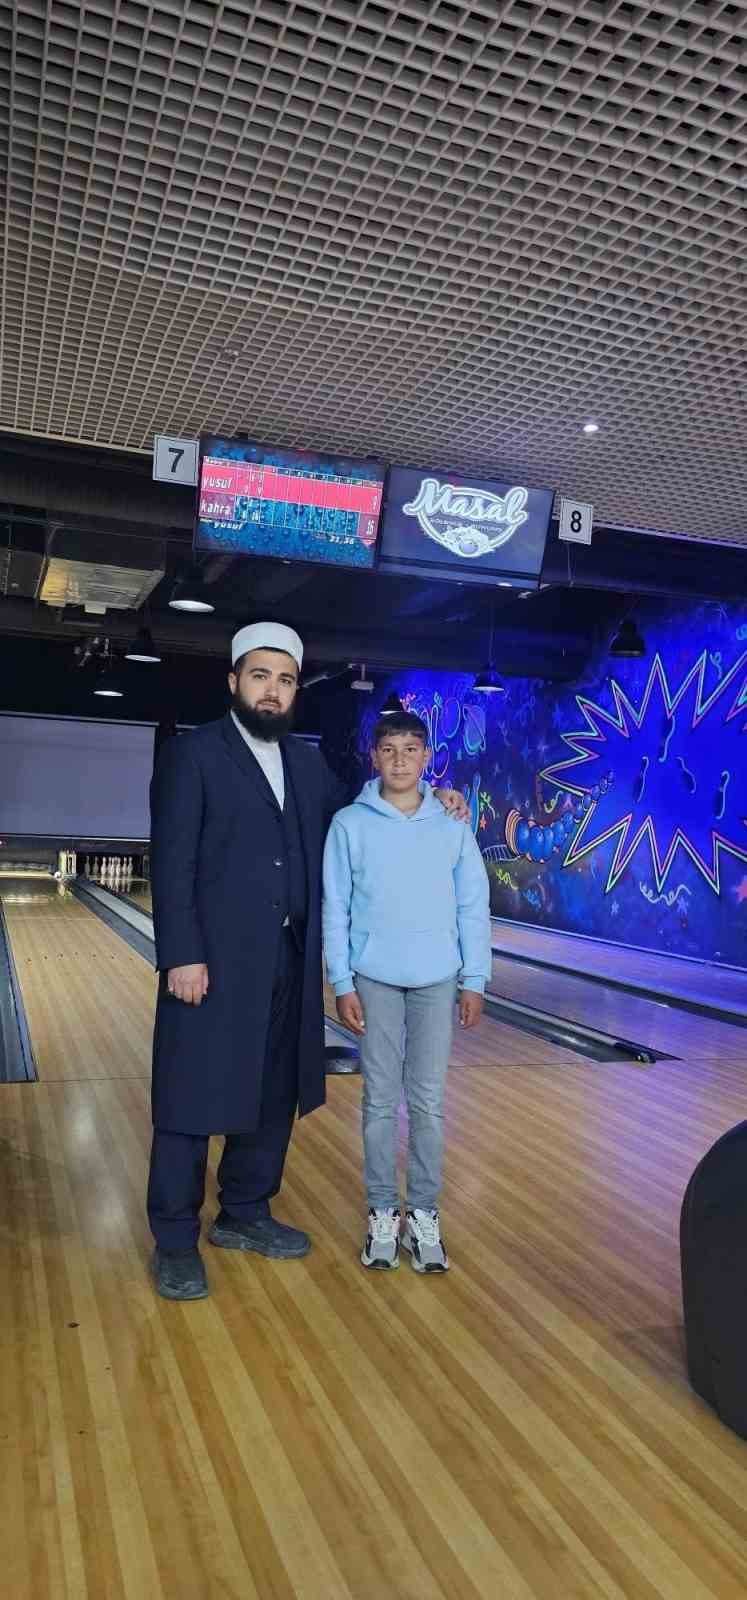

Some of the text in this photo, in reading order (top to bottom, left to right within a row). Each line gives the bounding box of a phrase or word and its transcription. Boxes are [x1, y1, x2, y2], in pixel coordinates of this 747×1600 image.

[168, 447, 185, 473] 7
[202, 475, 233, 489] yusuf
[403, 478, 528, 525] Masal
[213, 520, 244, 531] yusuf
[570, 510, 583, 533] 8
